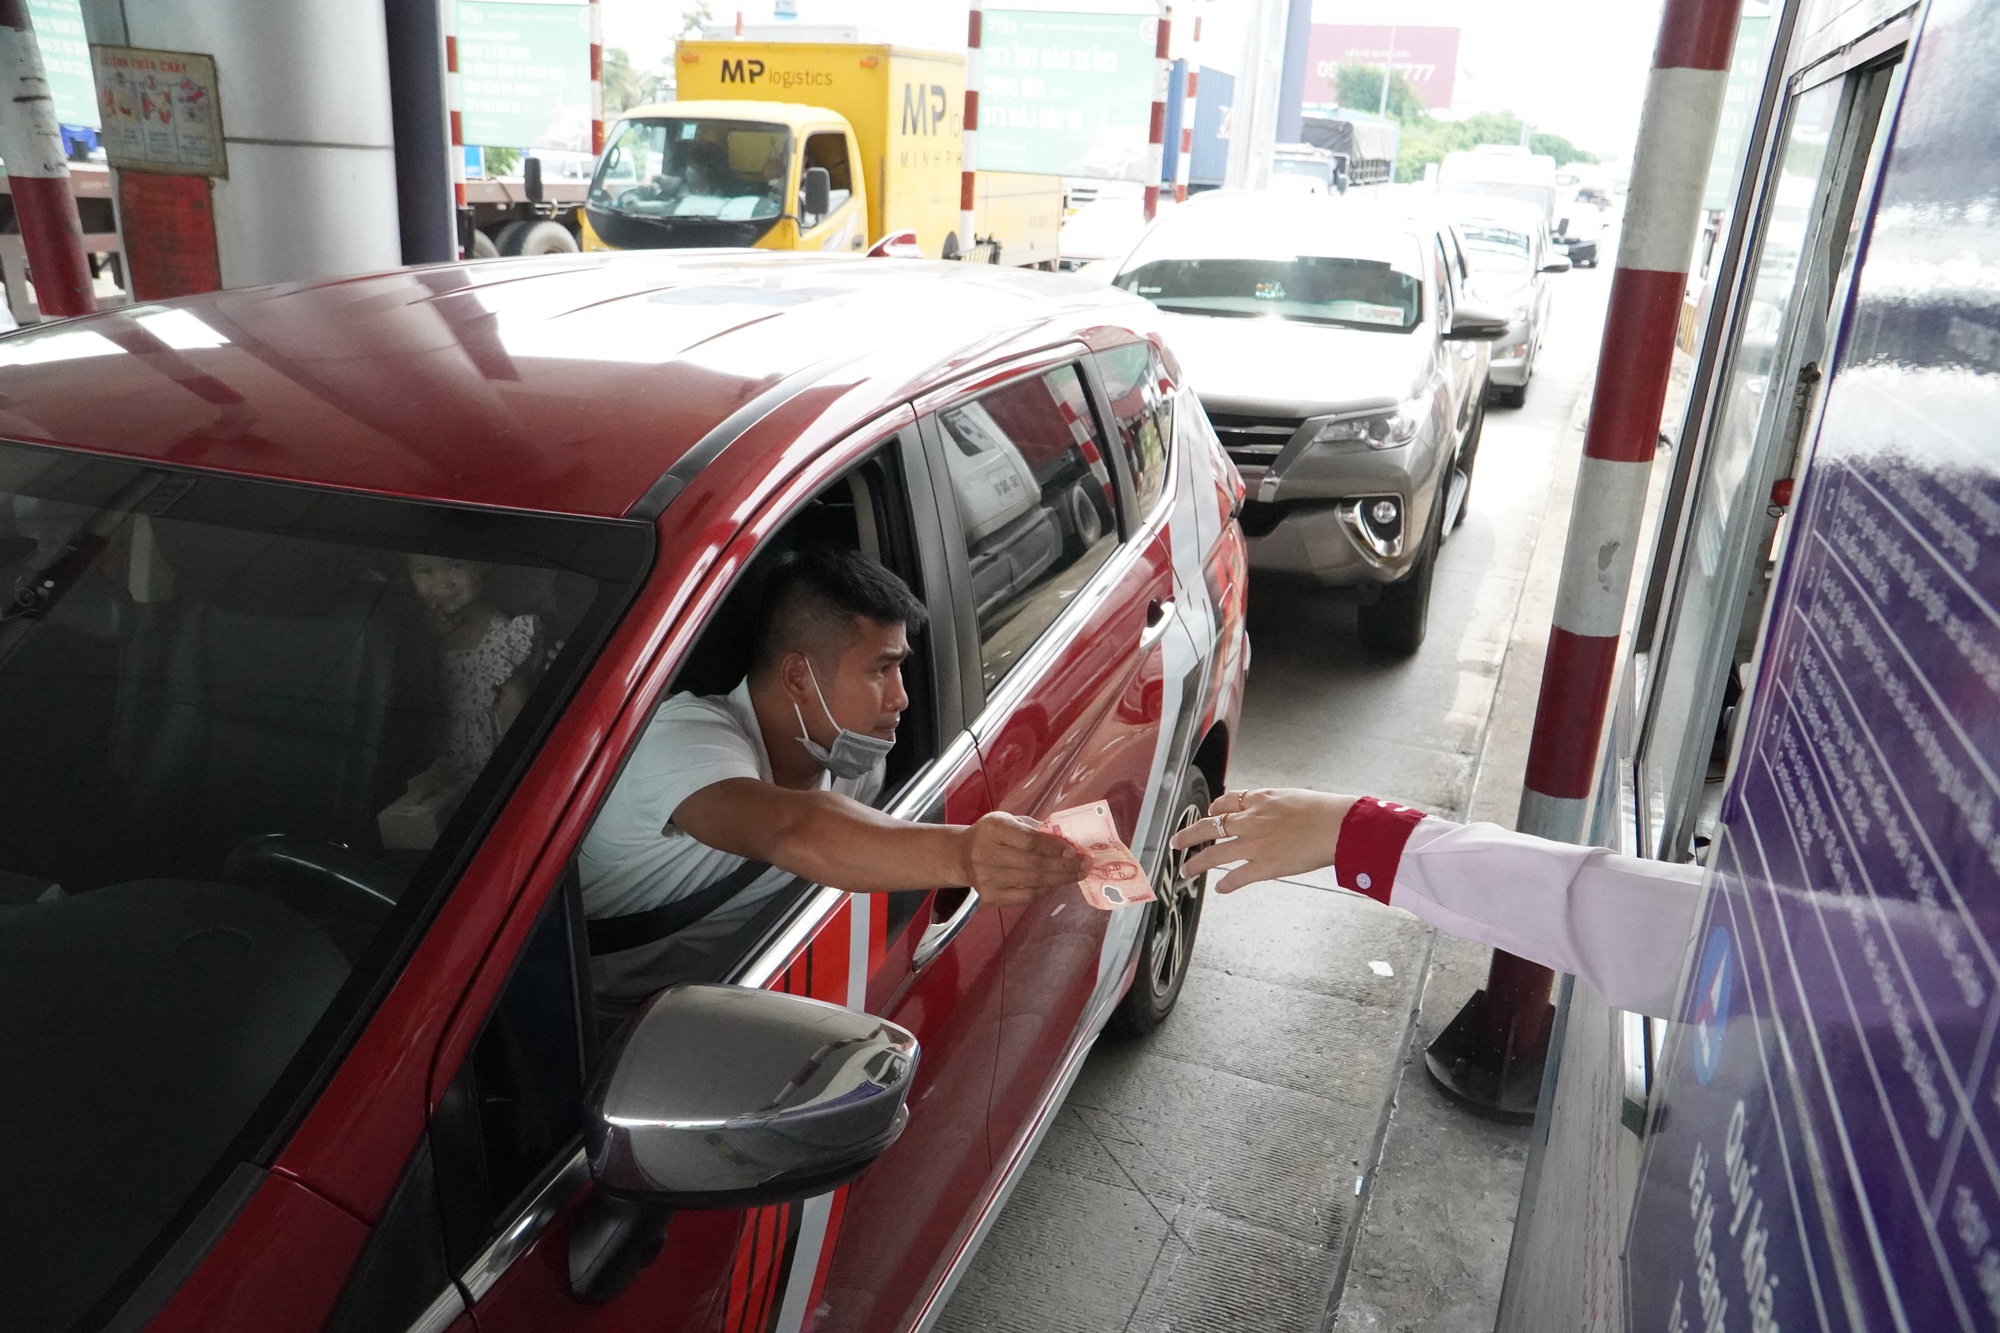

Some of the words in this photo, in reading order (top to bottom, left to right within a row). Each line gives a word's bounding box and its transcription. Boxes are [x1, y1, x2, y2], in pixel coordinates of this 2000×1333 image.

[720, 59, 765, 83] MP
[769, 68, 833, 89] logistics
[902, 83, 947, 136] MP
[1741, 1198, 1780, 1333] khá
